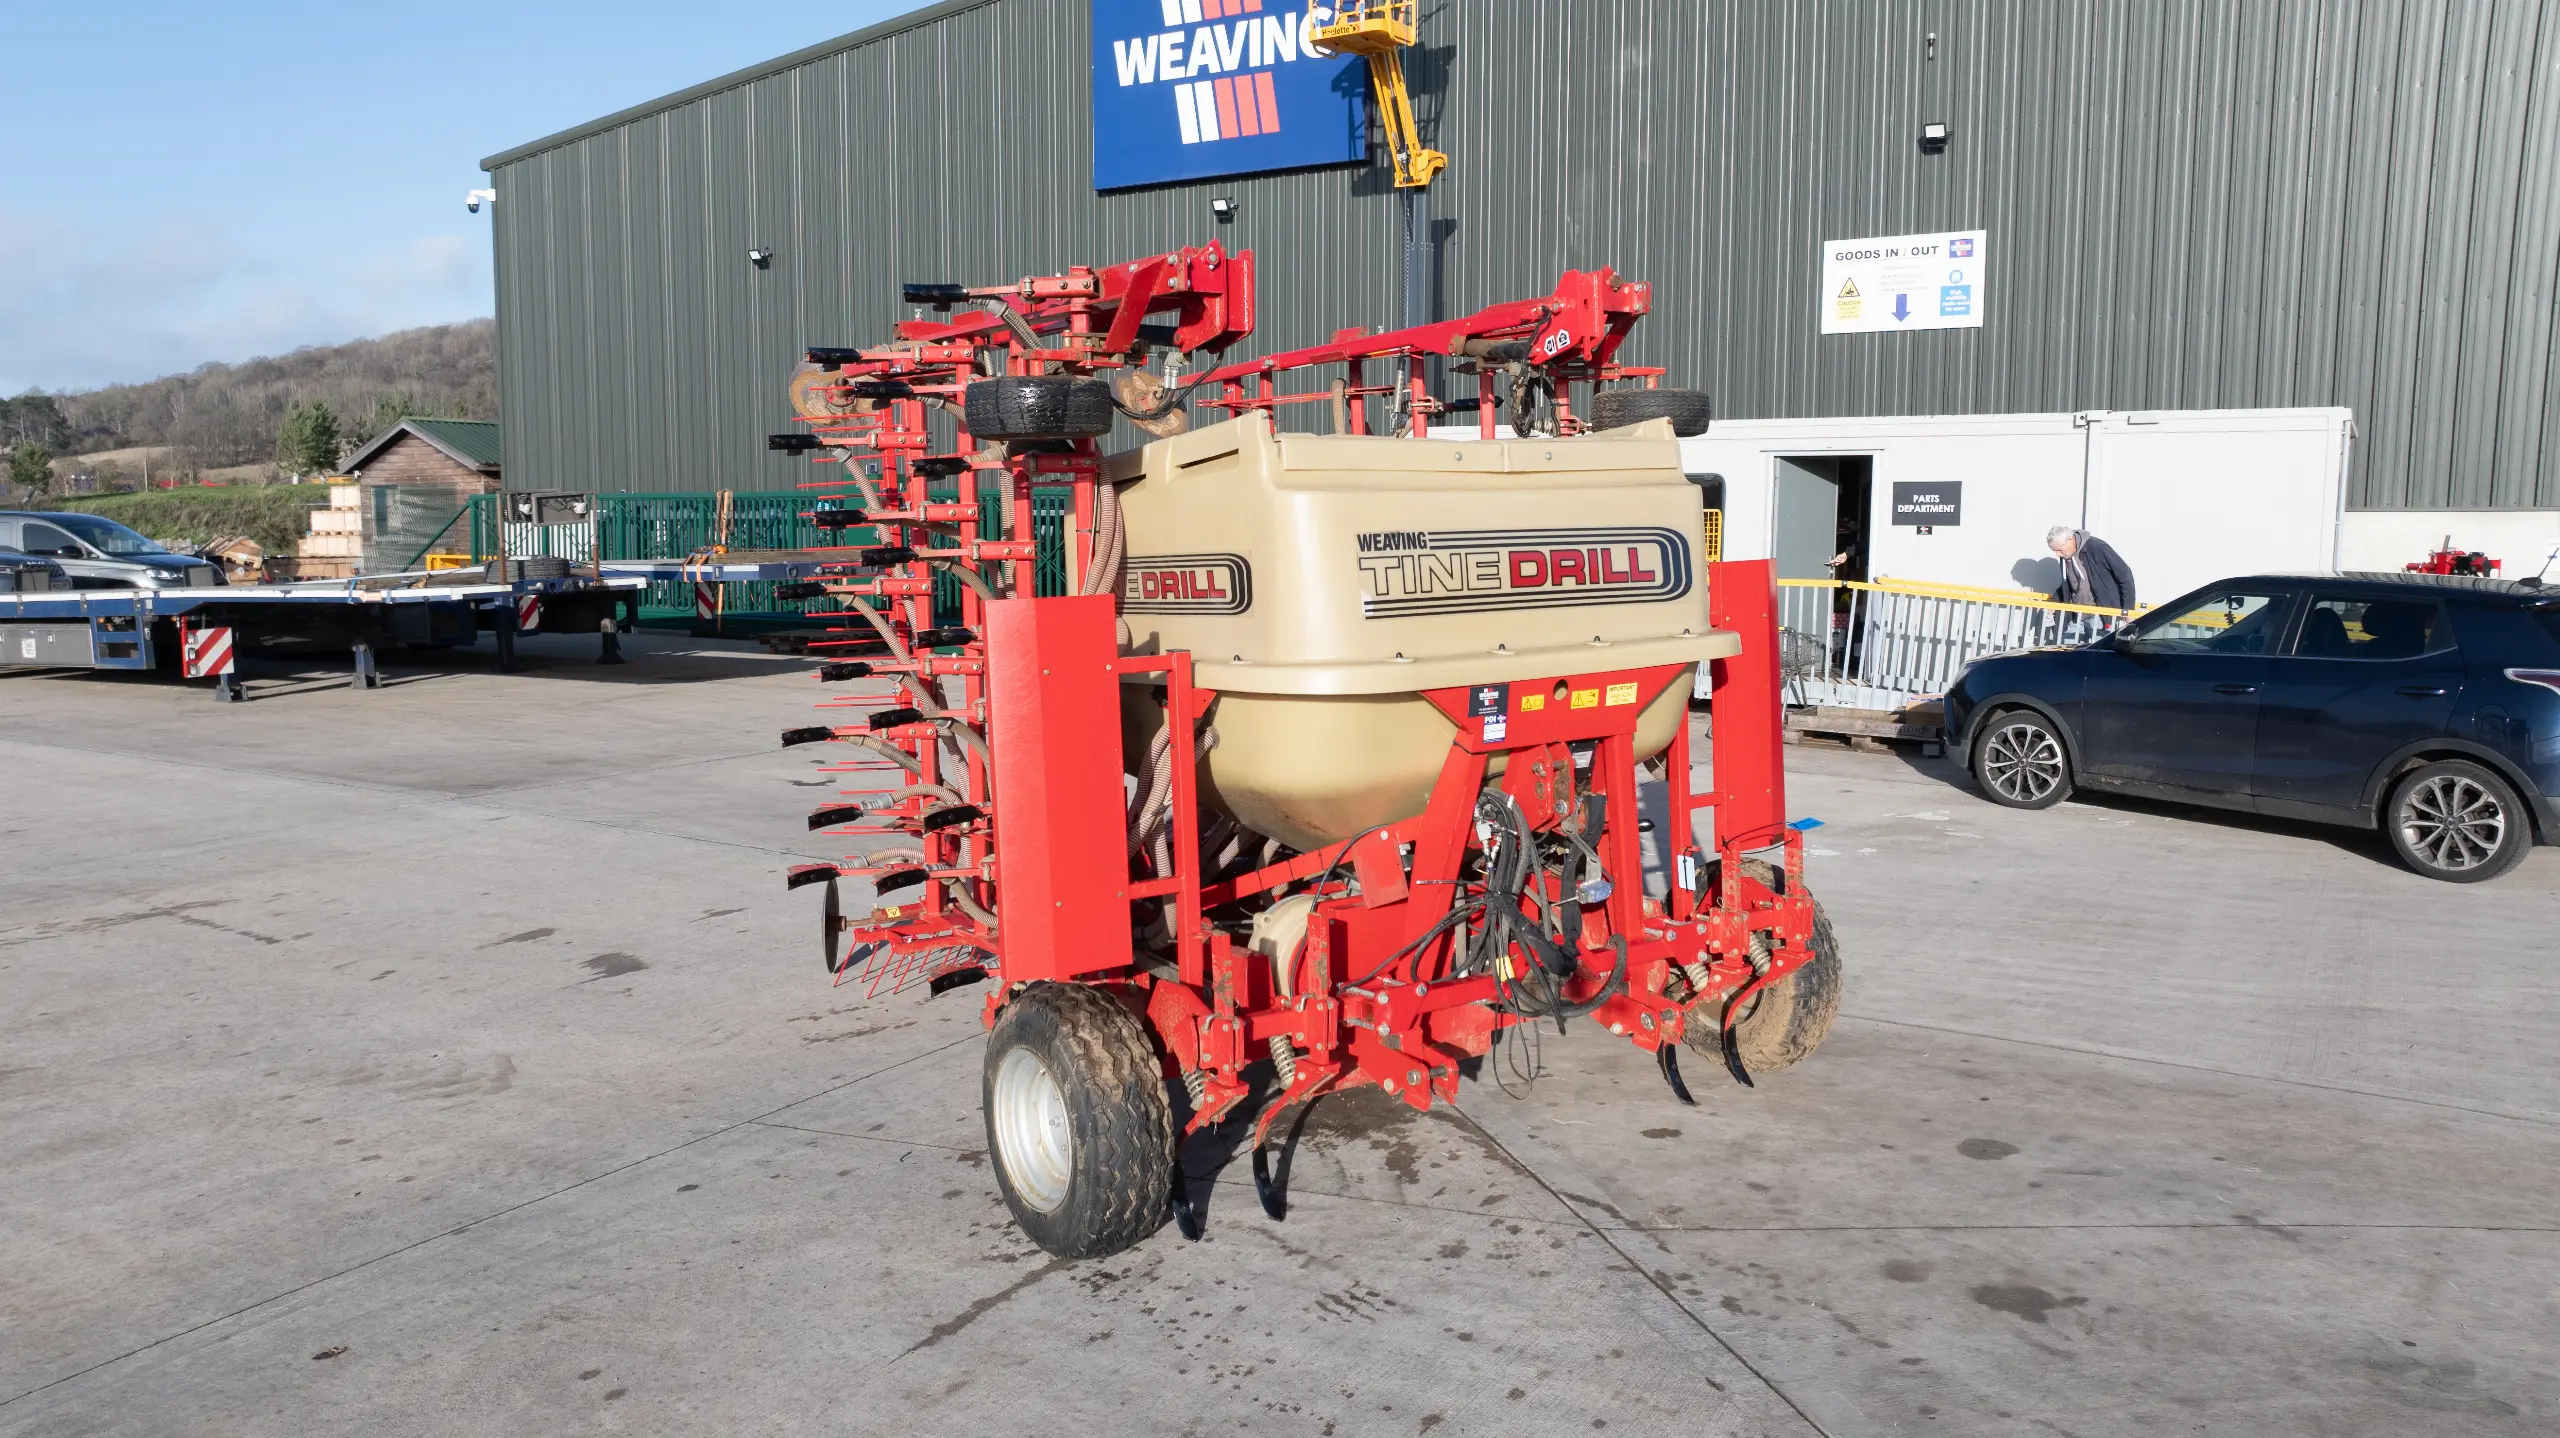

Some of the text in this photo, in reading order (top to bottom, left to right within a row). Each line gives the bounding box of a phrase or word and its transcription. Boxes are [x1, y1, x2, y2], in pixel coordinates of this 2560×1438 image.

[1835, 249, 1881, 261] GOODS
[1885, 248, 1899, 258] IN
[1911, 245, 1939, 256] OUT
[1913, 494, 1940, 503] PARTS
[1897, 504, 1956, 513] DEPARTMENT
[1356, 531, 1427, 552] WEAVING
[1141, 569, 1226, 599] DRILL
[1484, 715, 1497, 724] PDI
